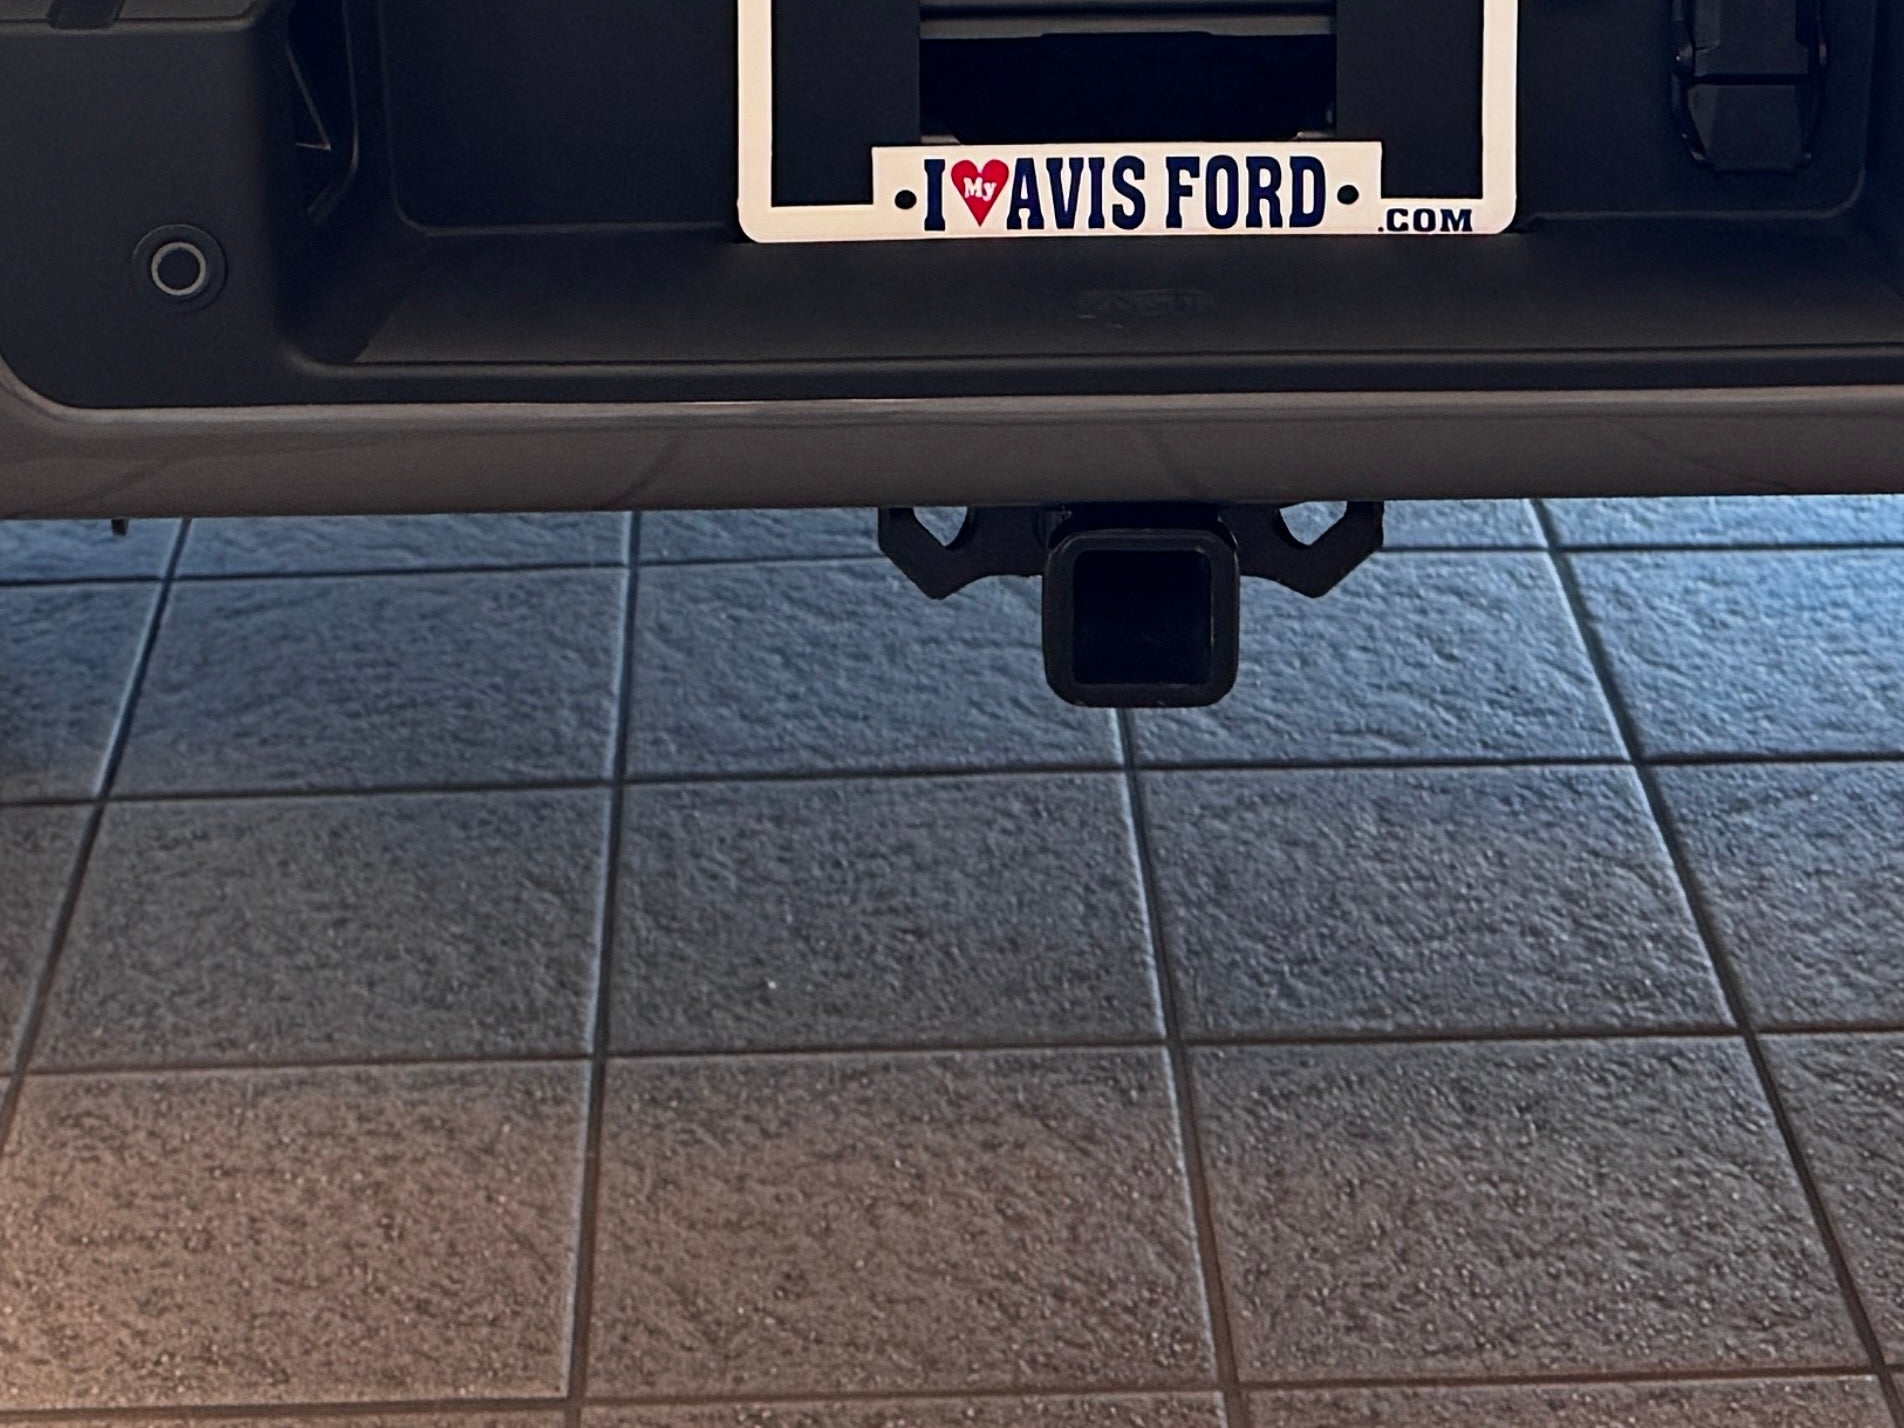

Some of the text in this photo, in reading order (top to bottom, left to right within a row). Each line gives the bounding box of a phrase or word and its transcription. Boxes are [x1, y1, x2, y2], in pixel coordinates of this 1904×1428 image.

[963, 175, 998, 204] My
[1006, 155, 1146, 230] AVIS
[1164, 154, 1327, 229] FORD
[1377, 206, 1474, 233] .COM
